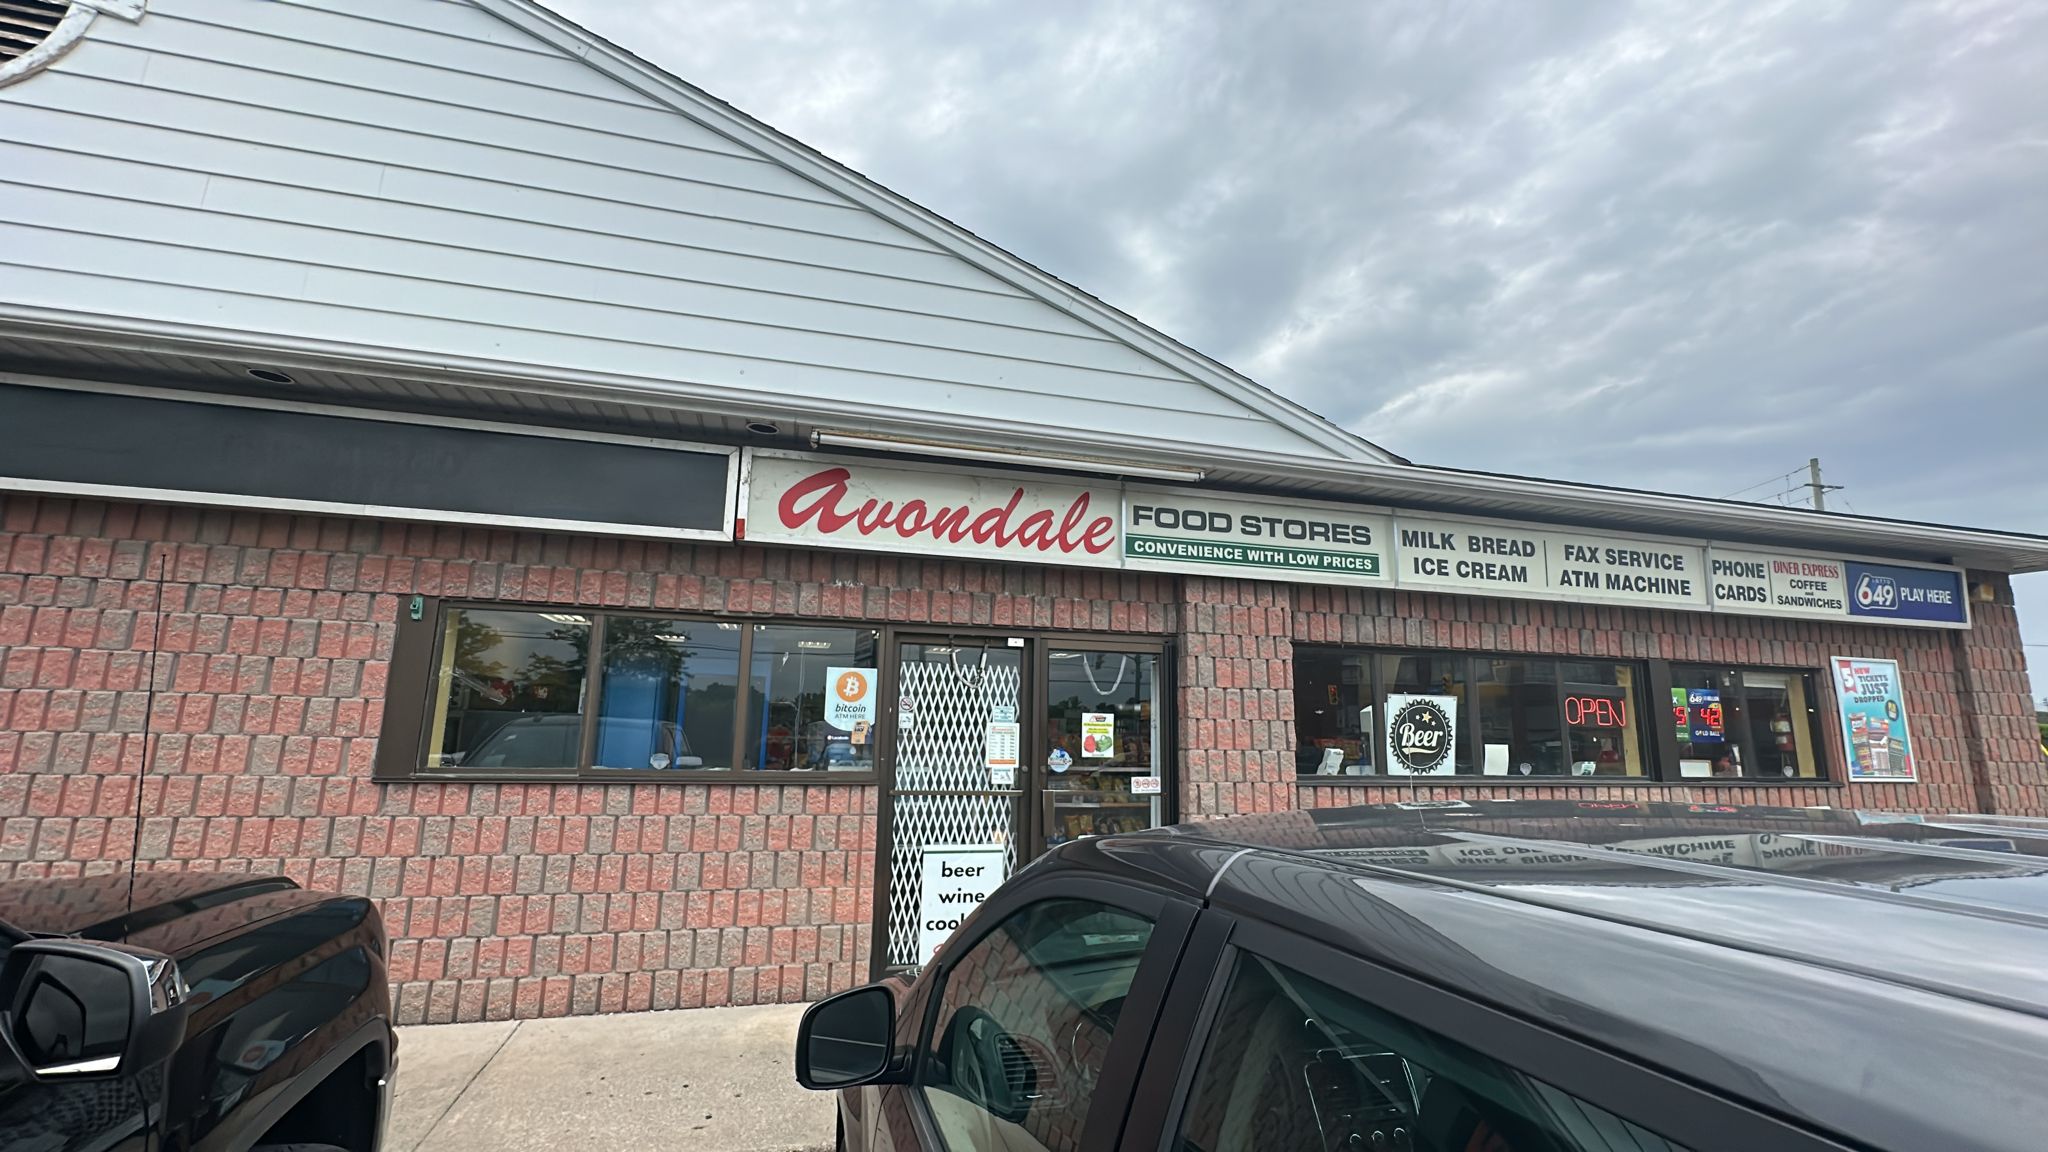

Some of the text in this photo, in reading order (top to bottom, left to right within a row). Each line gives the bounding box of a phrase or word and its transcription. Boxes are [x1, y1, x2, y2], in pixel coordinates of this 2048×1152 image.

[1133, 505, 1371, 545] FOOD STORES
[1402, 530, 1535, 557] MILK BREAD
[1134, 541, 1372, 570] CONVENIENCE WITH LOW PRICES
[1564, 544, 1683, 571] FAX SERVICE
[1414, 557, 1527, 582] ICE CREAM
[1712, 559, 1765, 579] PHONE
[1773, 560, 1839, 579] DINER EXPRESS
[1560, 570, 1691, 595] ATM MACHINE
[1790, 579, 1828, 591] COFFEE
[1715, 583, 1767, 603] CARDS
[1777, 595, 1842, 609] SANDWICHES
[1900, 587, 1953, 604] PLAY HERE
[1857, 675, 1889, 683] TICKETS
[1861, 683, 1889, 695] JUST
[835, 704, 866, 713] bitcoin
[1854, 695, 1885, 704] DROPPED
[1565, 697, 1627, 727] OPEN
[1700, 708, 1721, 726] 42
[1400, 722, 1443, 747] Beer
[941, 861, 984, 877] beer
[938, 888, 984, 903] wine
